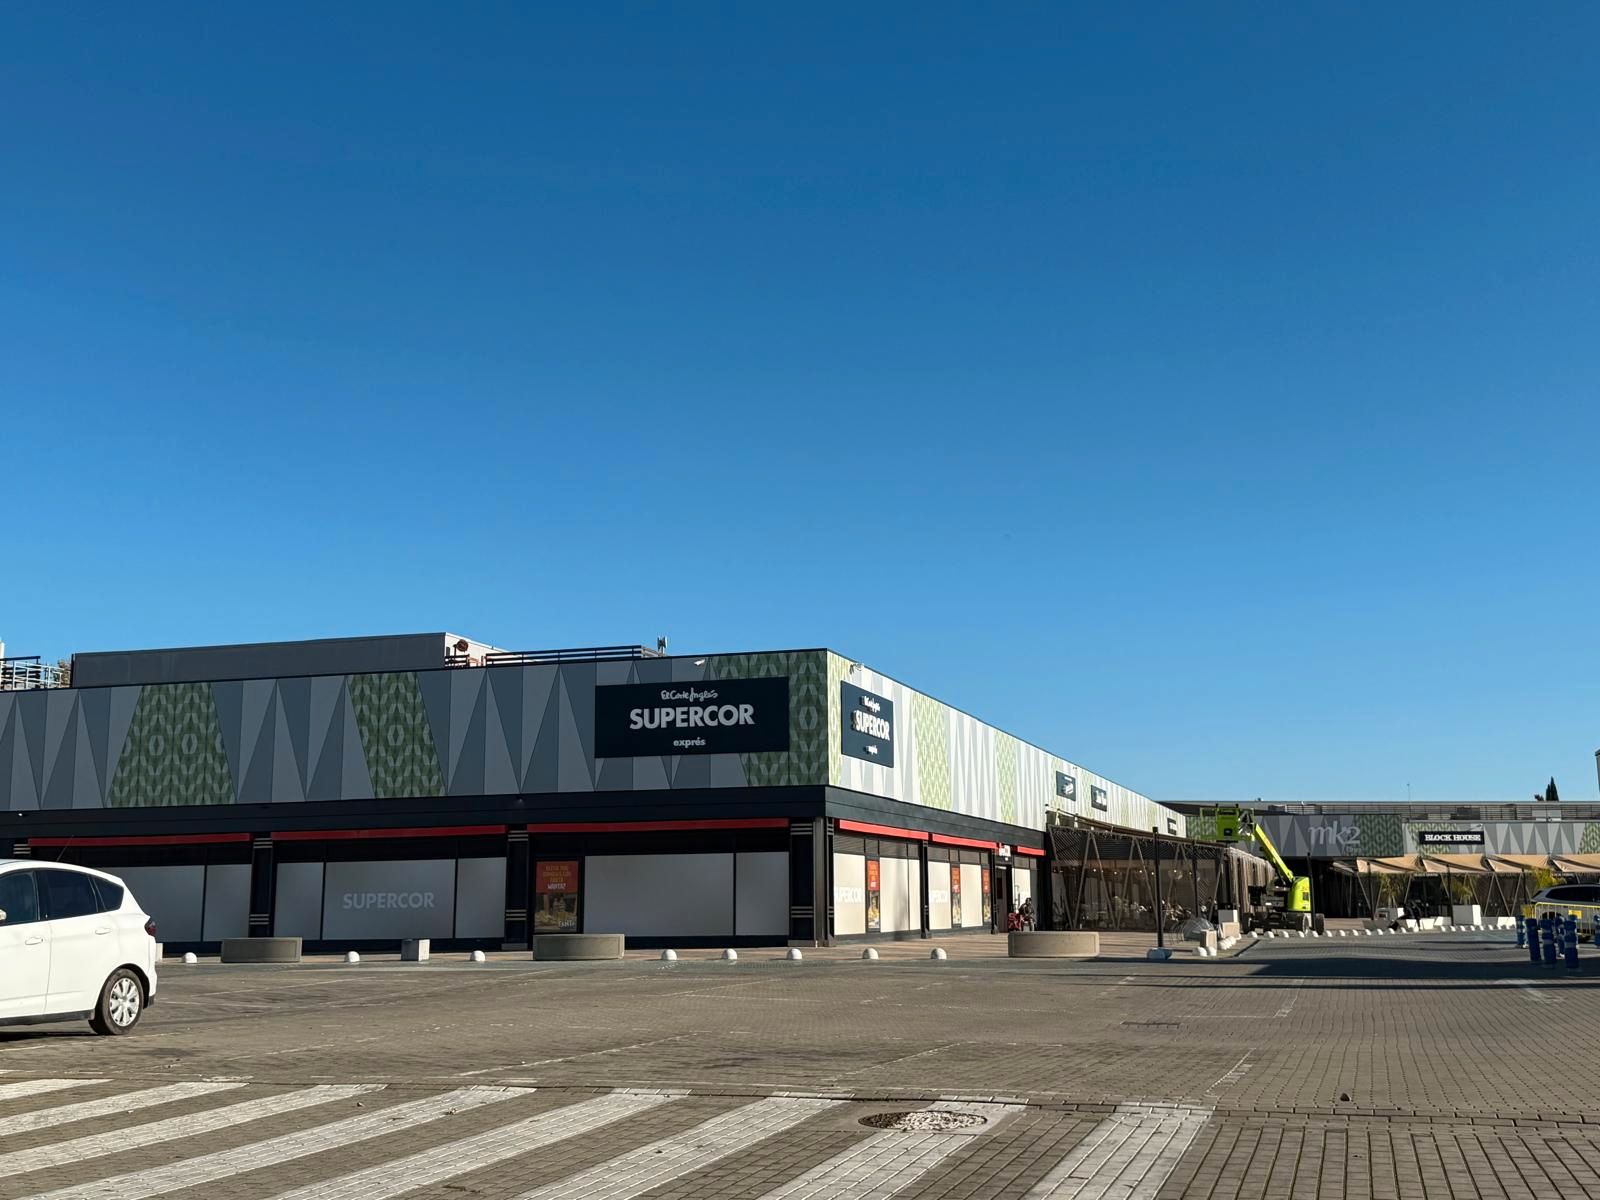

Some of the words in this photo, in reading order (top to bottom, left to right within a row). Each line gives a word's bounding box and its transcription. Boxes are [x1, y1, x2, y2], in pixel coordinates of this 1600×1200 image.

[660, 690, 670, 700] El
[670, 690, 689, 700] Corte
[629, 704, 755, 730] SUPERCOR
[854, 710, 890, 741] SUPERCOR
[673, 736, 706, 749] exprés
[1307, 820, 1361, 845] mk2
[1424, 834, 1452, 842] BLOCK
[1453, 834, 1481, 842] HOUSE
[342, 892, 435, 909] SUPERCOR
